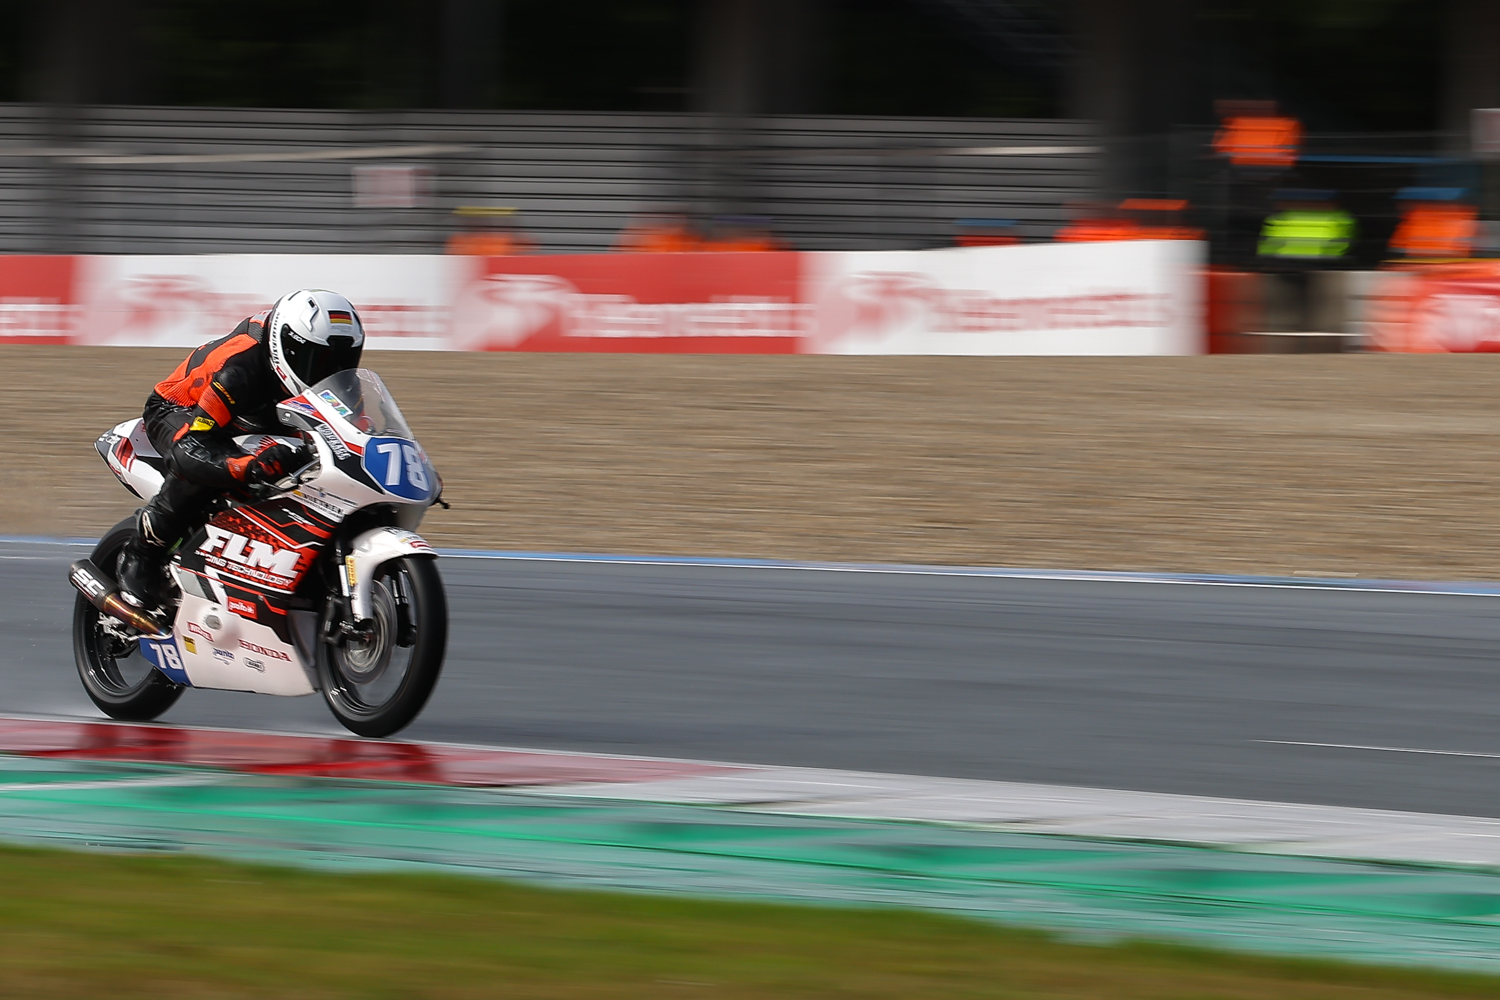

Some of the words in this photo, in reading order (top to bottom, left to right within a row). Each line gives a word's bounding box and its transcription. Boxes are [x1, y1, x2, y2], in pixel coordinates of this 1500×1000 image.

[376, 443, 429, 491] 78
[199, 523, 301, 579] FLM
[72, 568, 105, 598] SC
[149, 642, 184, 670] 78
[238, 639, 293, 662] HONDA
